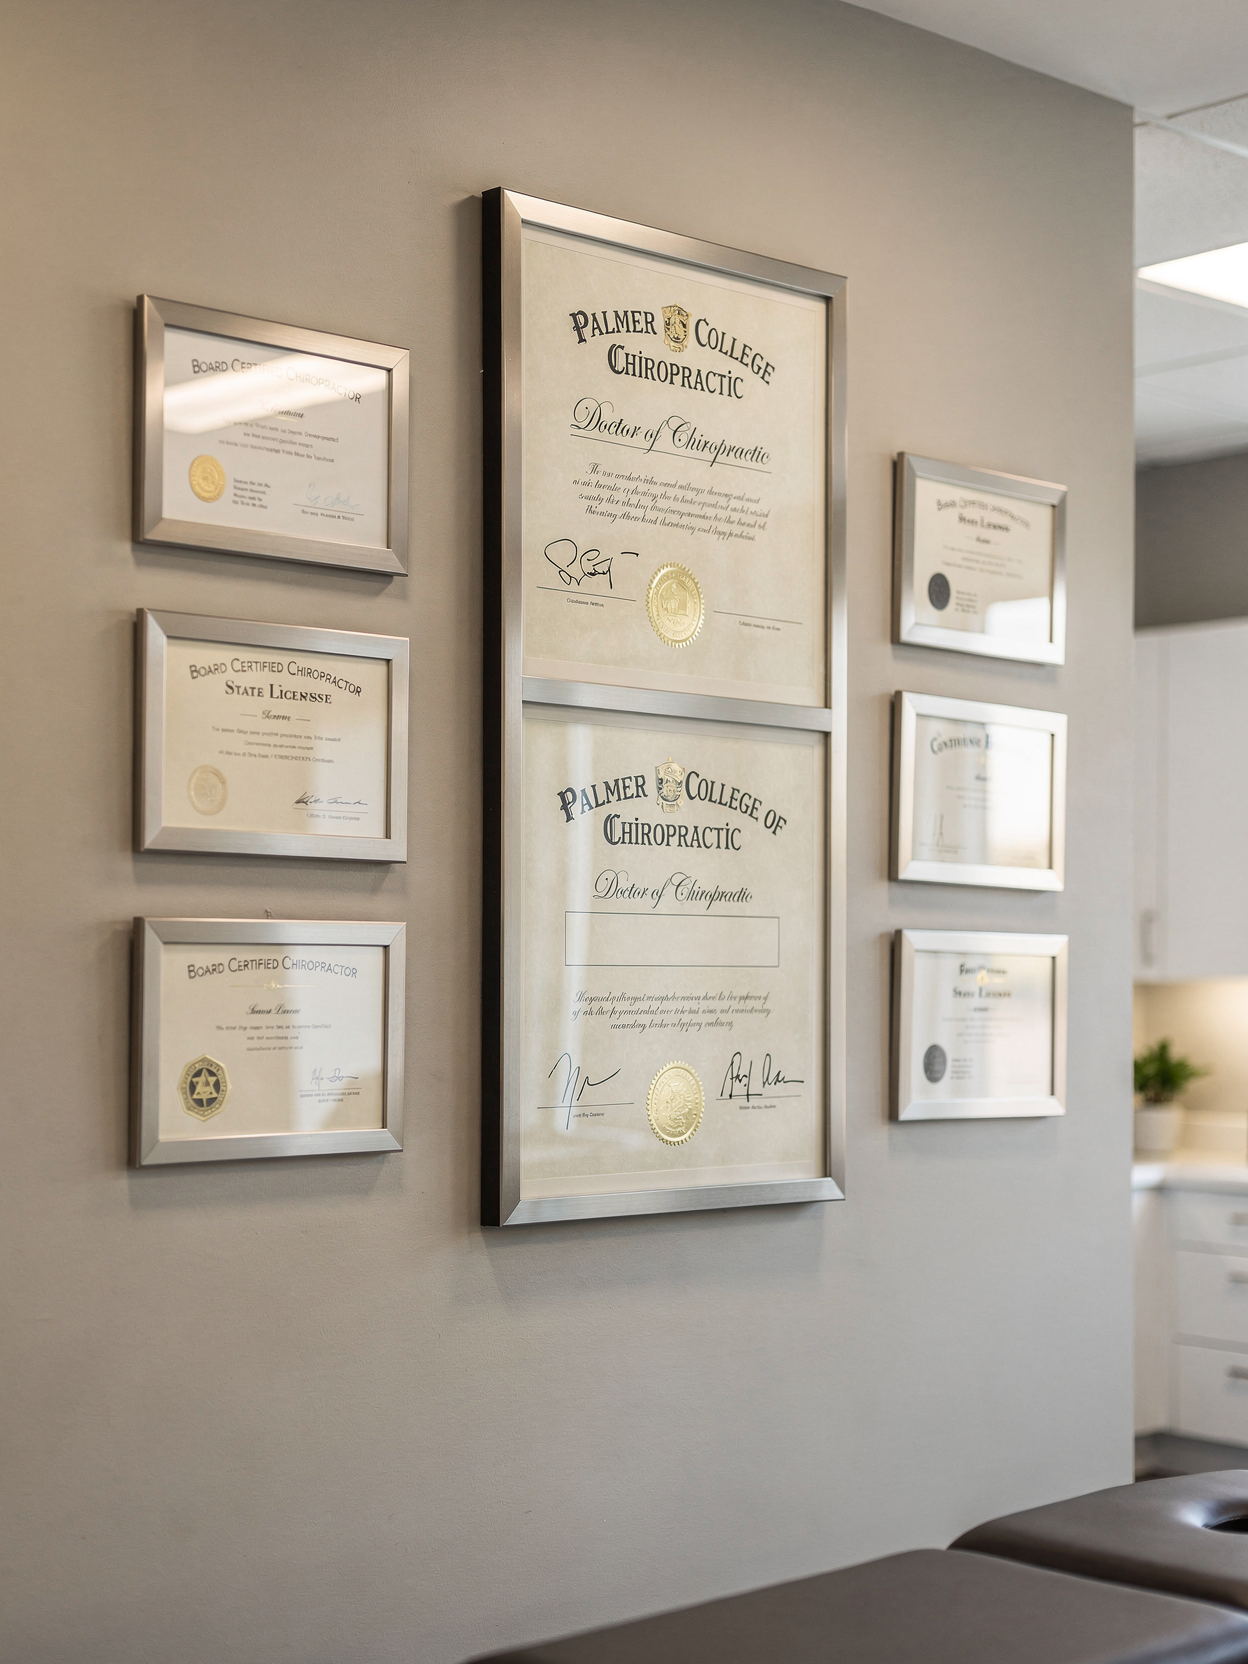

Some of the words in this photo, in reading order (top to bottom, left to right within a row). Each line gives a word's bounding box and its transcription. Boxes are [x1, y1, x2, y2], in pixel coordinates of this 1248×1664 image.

[569, 309, 658, 345] PALMER
[694, 317, 775, 386] COLLEGE
[191, 358, 229, 375] BOARD
[286, 366, 362, 404] CHIROPRACTOR
[607, 343, 744, 400] CHIROPRACTIC
[570, 397, 641, 439] Doctor
[643, 419, 669, 455] of
[667, 415, 772, 467] Chiropractic
[189, 662, 227, 680] BOARD
[231, 658, 284, 673] CERTIFIED
[287, 661, 362, 697] CHIROPRACTOR
[224, 679, 264, 699] STATE
[557, 774, 648, 823] PALMER
[685, 770, 763, 821] COLLEGE
[764, 809, 787, 836] OF
[603, 813, 742, 851] CHIROPRACTIC
[592, 869, 648, 900] Doctor
[650, 878, 671, 909] of
[187, 963, 225, 980] BOARD
[228, 957, 279, 973] CERTIFIED
[282, 956, 358, 979] CHIROPRACTOR
